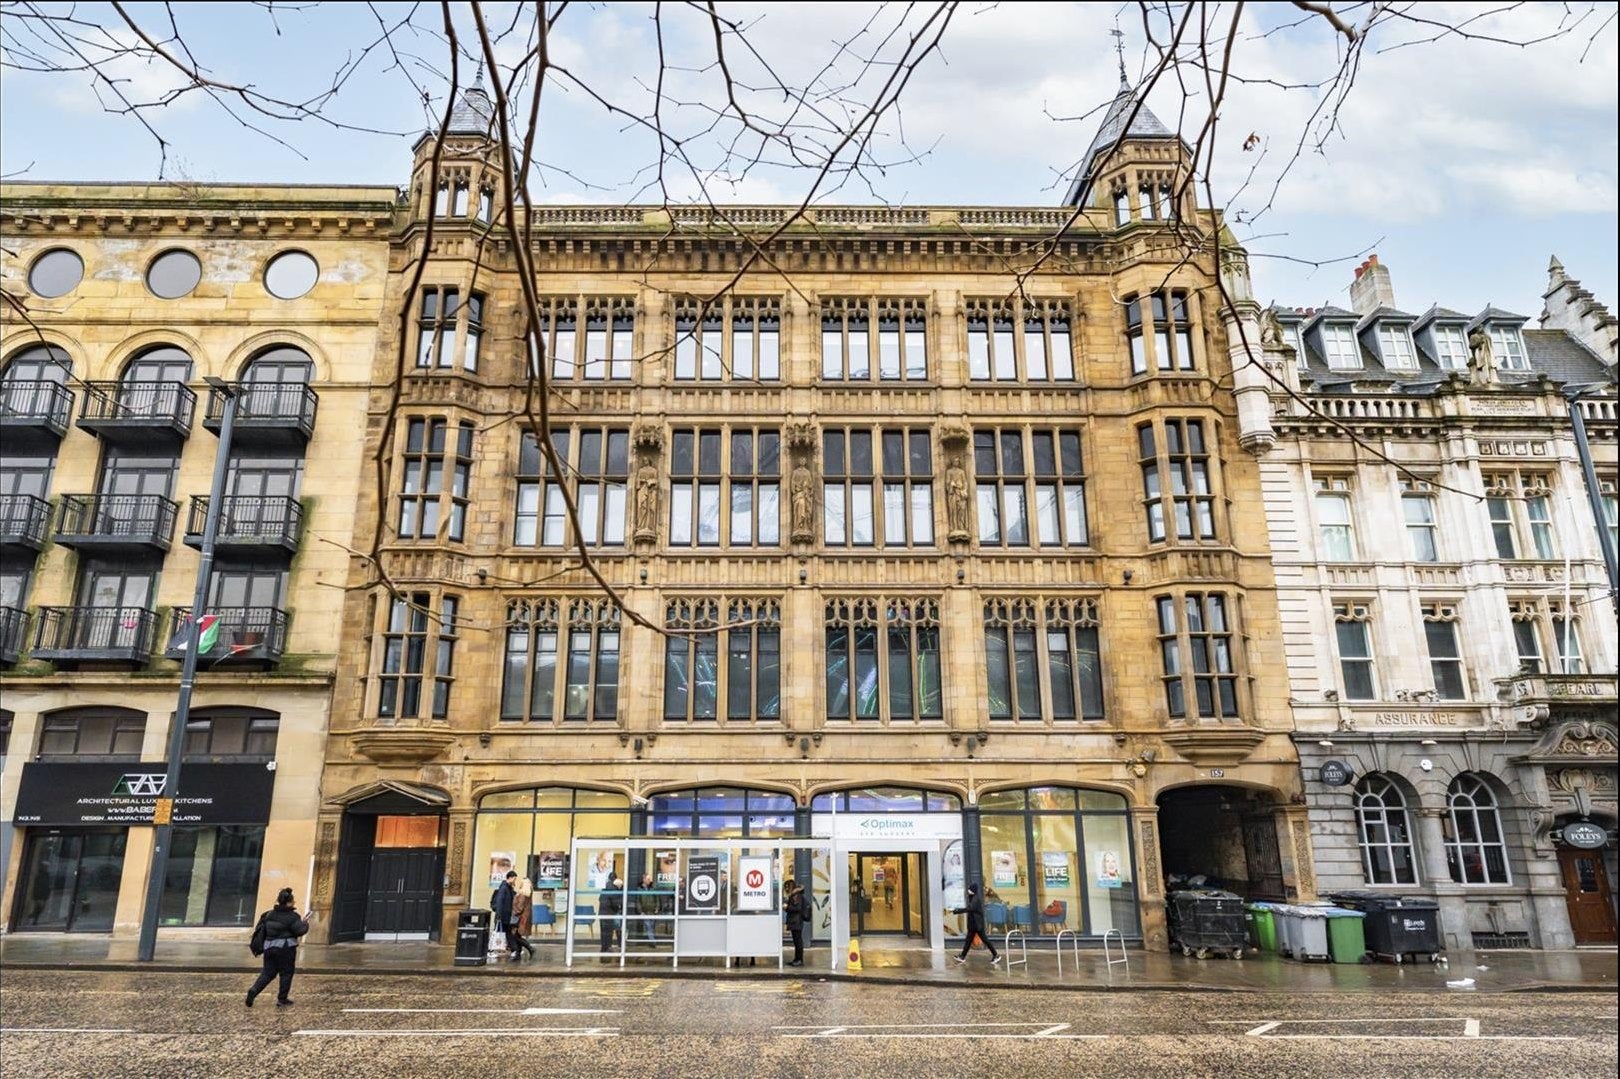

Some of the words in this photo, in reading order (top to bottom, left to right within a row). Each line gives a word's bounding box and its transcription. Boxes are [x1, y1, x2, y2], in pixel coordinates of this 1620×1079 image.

[1375, 712, 1457, 725] ASSURANCE
[1211, 769, 1224, 777] 157
[871, 819, 914, 831] Optimax
[541, 867, 563, 876] LIFE
[1045, 867, 1068, 876] LIFE
